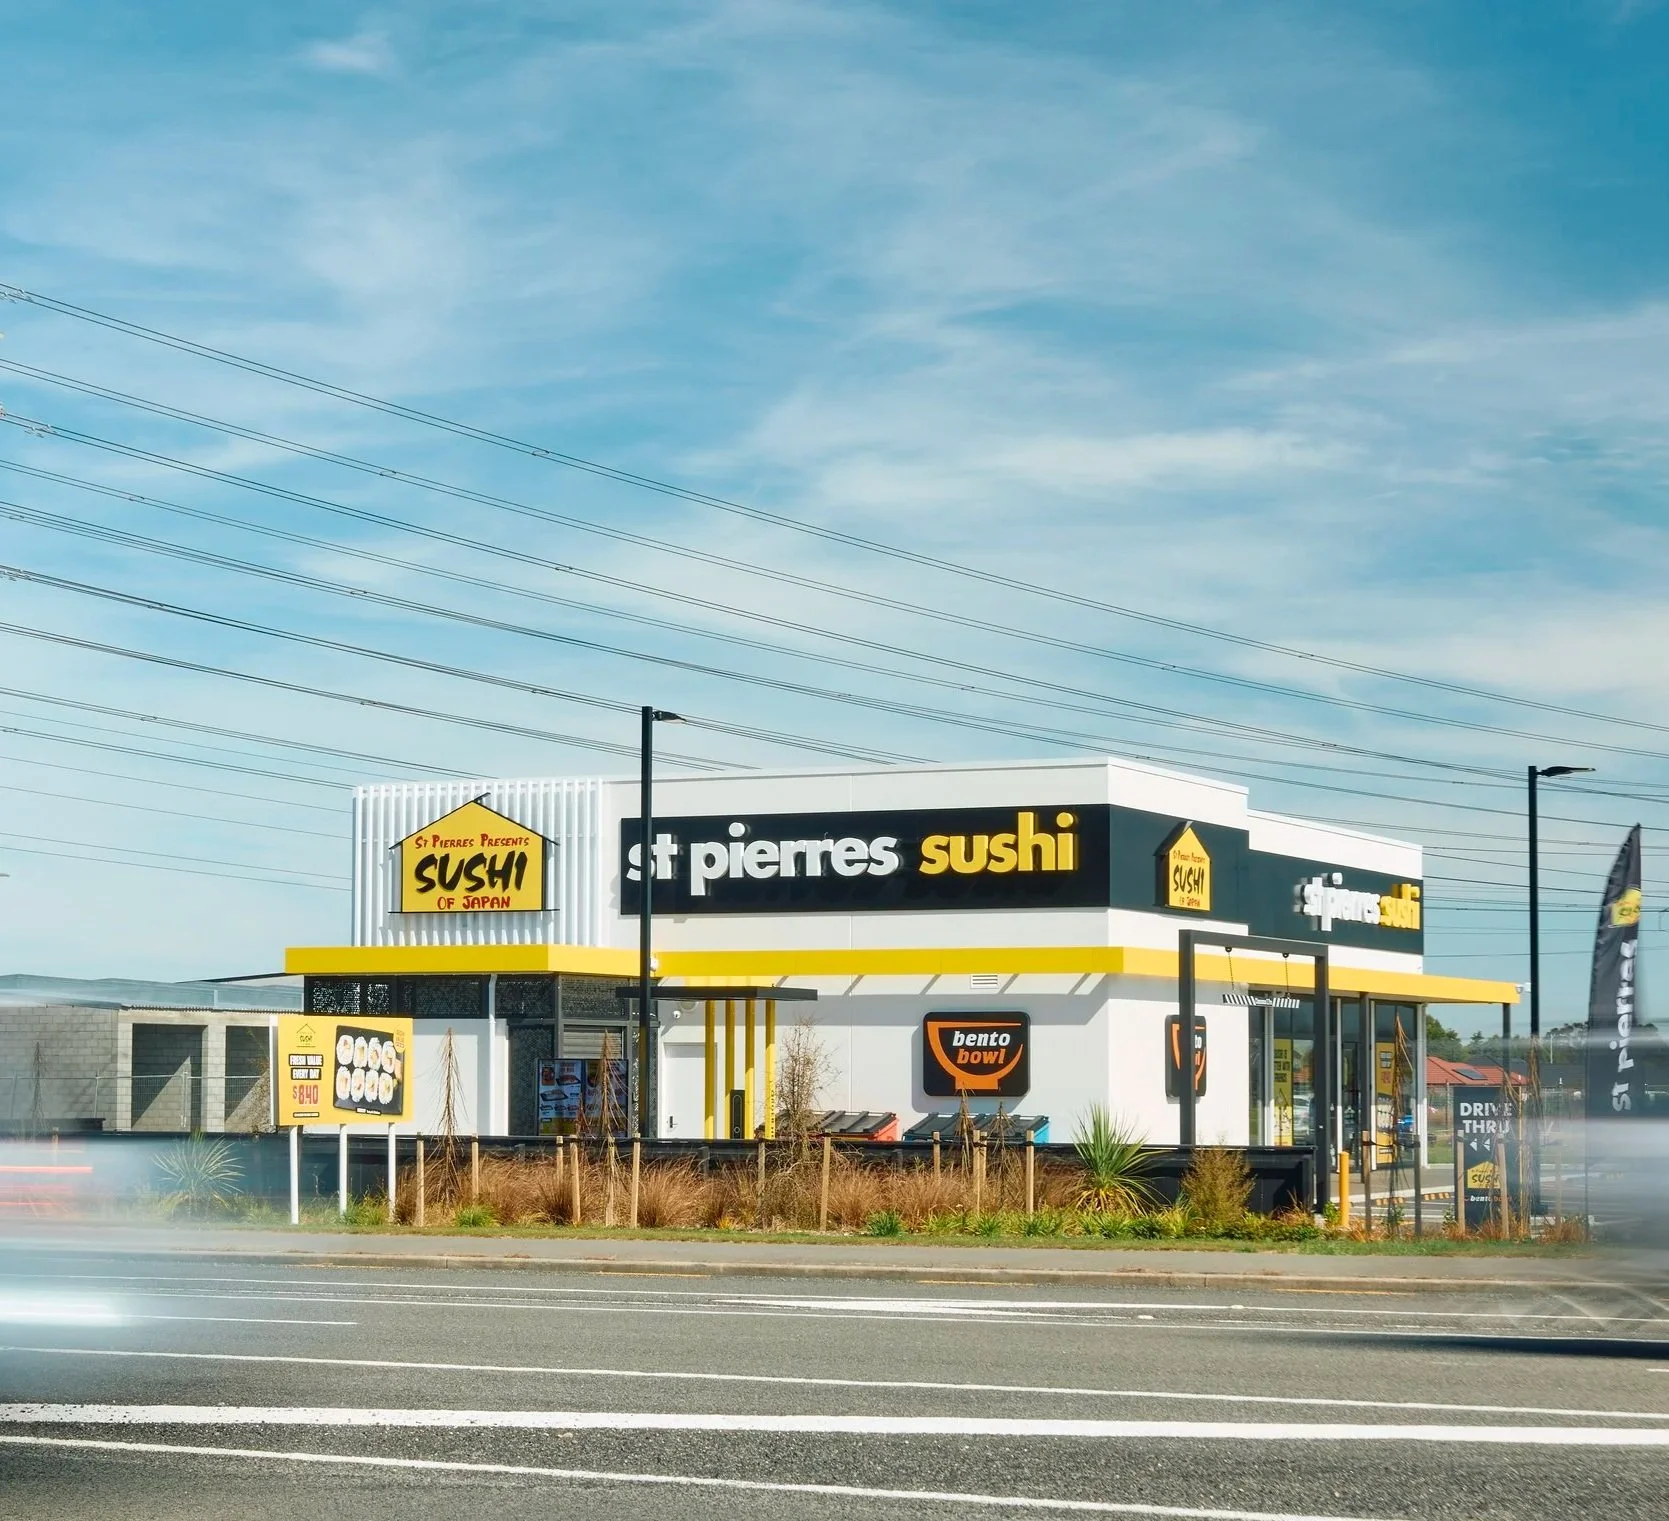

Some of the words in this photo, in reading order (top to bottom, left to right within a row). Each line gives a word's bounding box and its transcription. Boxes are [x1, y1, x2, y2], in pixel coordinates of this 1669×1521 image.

[626, 833, 678, 881] st
[690, 822, 900, 896] pierres
[919, 811, 1075, 874] sushi
[414, 850, 528, 894] SUSHI
[1173, 864, 1205, 894] SUSHI
[437, 896, 455, 910] OF
[462, 895, 511, 909] JAPAN
[952, 1031, 1011, 1047] bento
[290, 1055, 306, 1065] FRESH
[307, 1055, 323, 1065] VALUE
[957, 1048, 1006, 1064] bowl
[293, 1069, 308, 1079] EVERY
[309, 1069, 320, 1079] DAY
[1460, 1102, 1512, 1116] DRIVE
[1462, 1120, 1510, 1134] THRU
